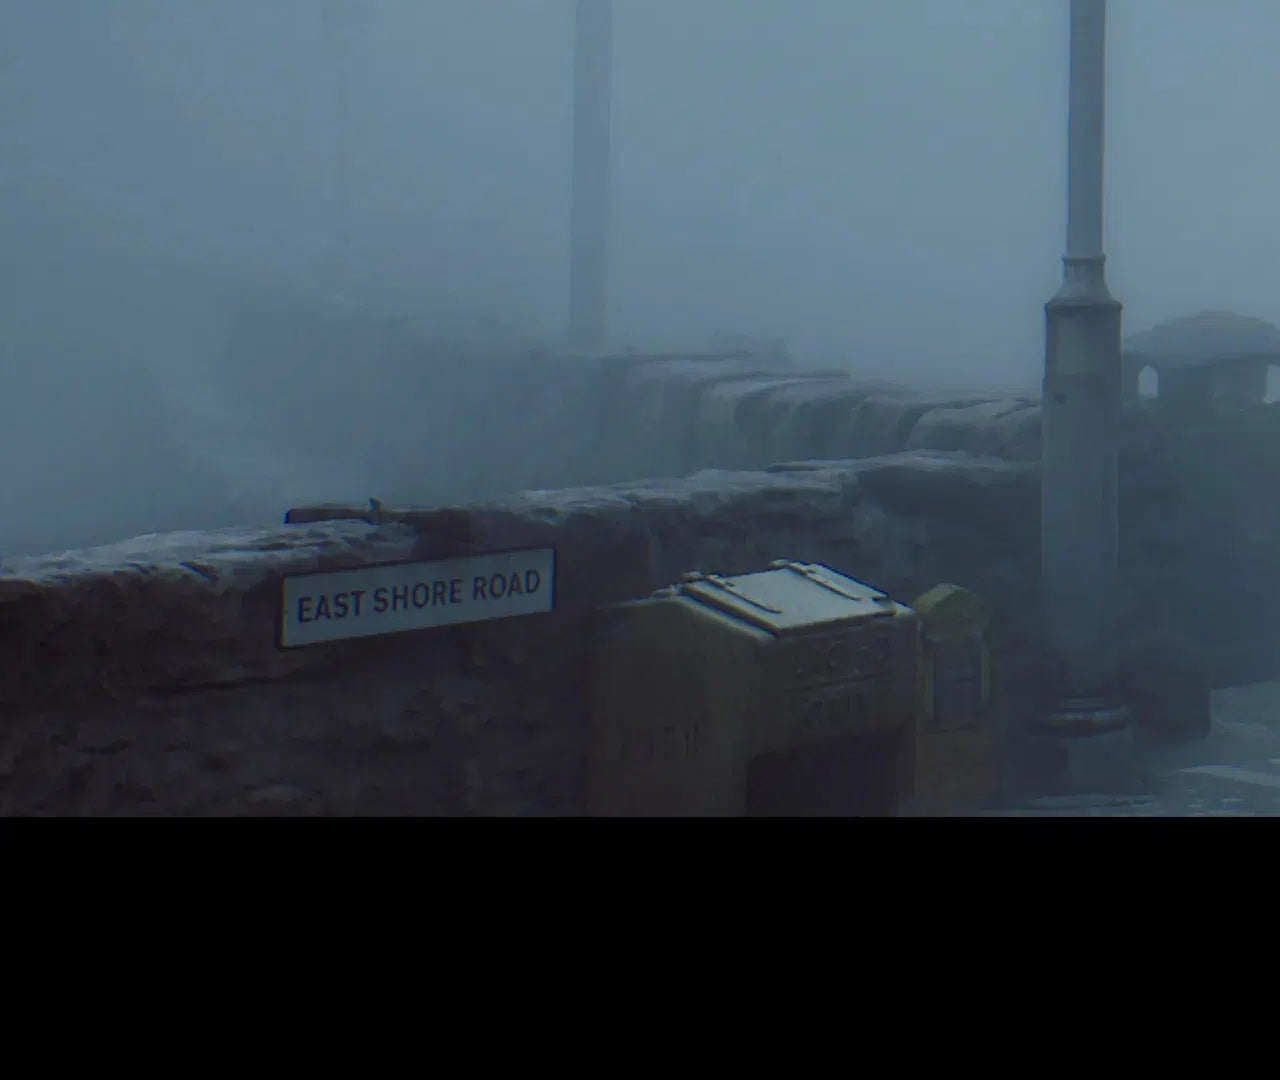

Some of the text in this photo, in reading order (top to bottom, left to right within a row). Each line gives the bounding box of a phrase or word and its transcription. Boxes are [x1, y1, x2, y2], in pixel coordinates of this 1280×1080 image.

[297, 568, 542, 623] EAST SHORE ROAD
